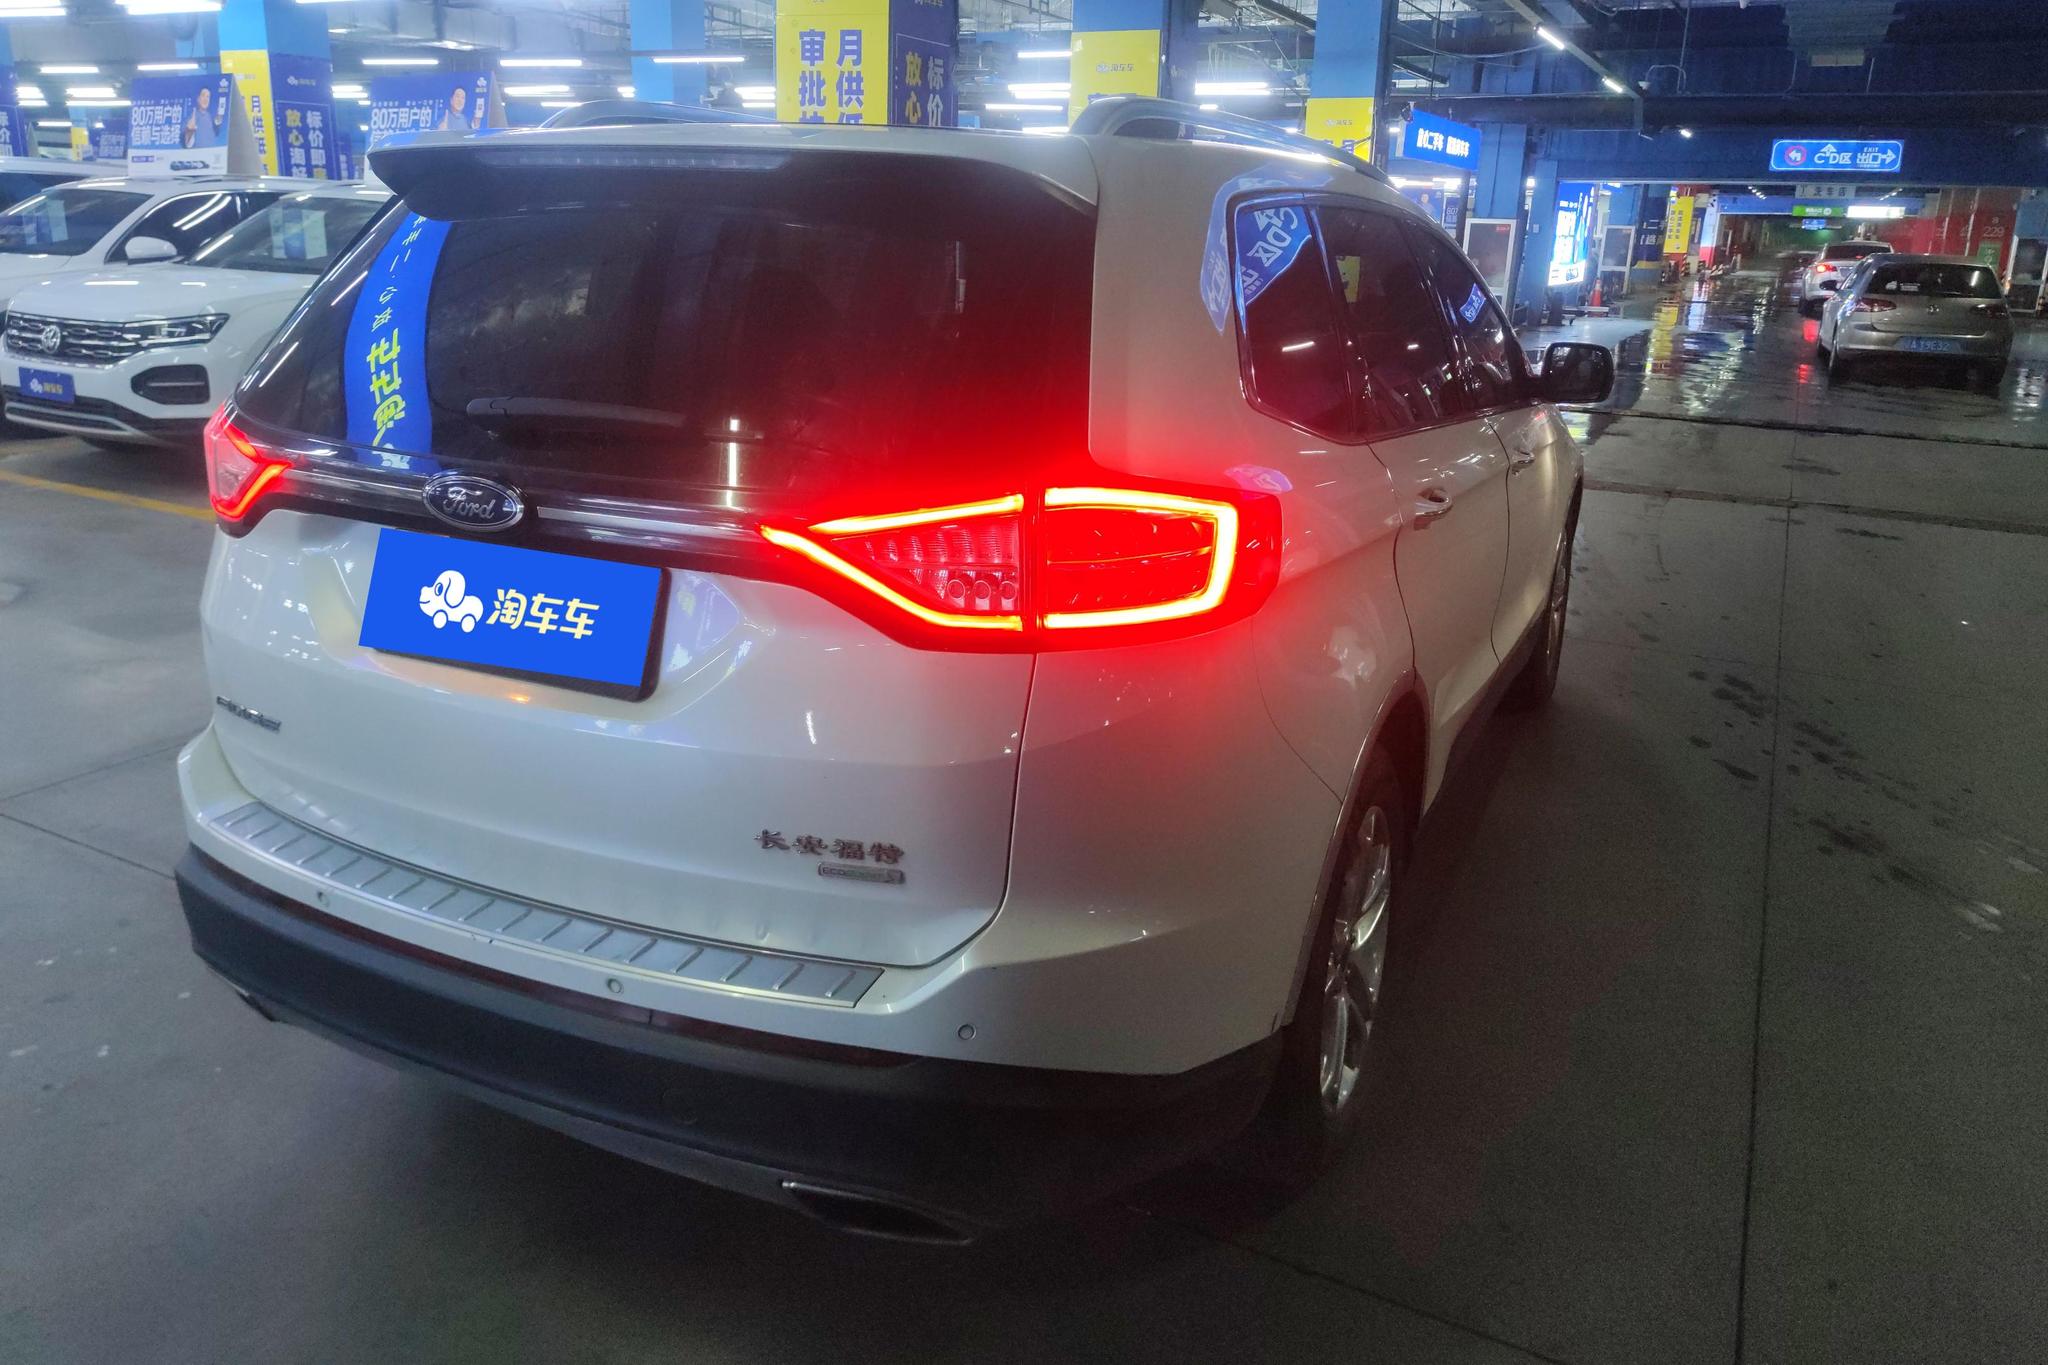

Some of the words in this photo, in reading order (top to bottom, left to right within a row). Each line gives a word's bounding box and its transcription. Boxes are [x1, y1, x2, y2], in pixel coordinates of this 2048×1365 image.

[905, 51, 922, 124] 放心
[131, 105, 182, 125] 80万用户的
[371, 105, 432, 129] 80万用户的
[1856, 152, 1881, 165] 出口
[443, 486, 496, 519] Ford
[753, 828, 905, 865] 长安福特
